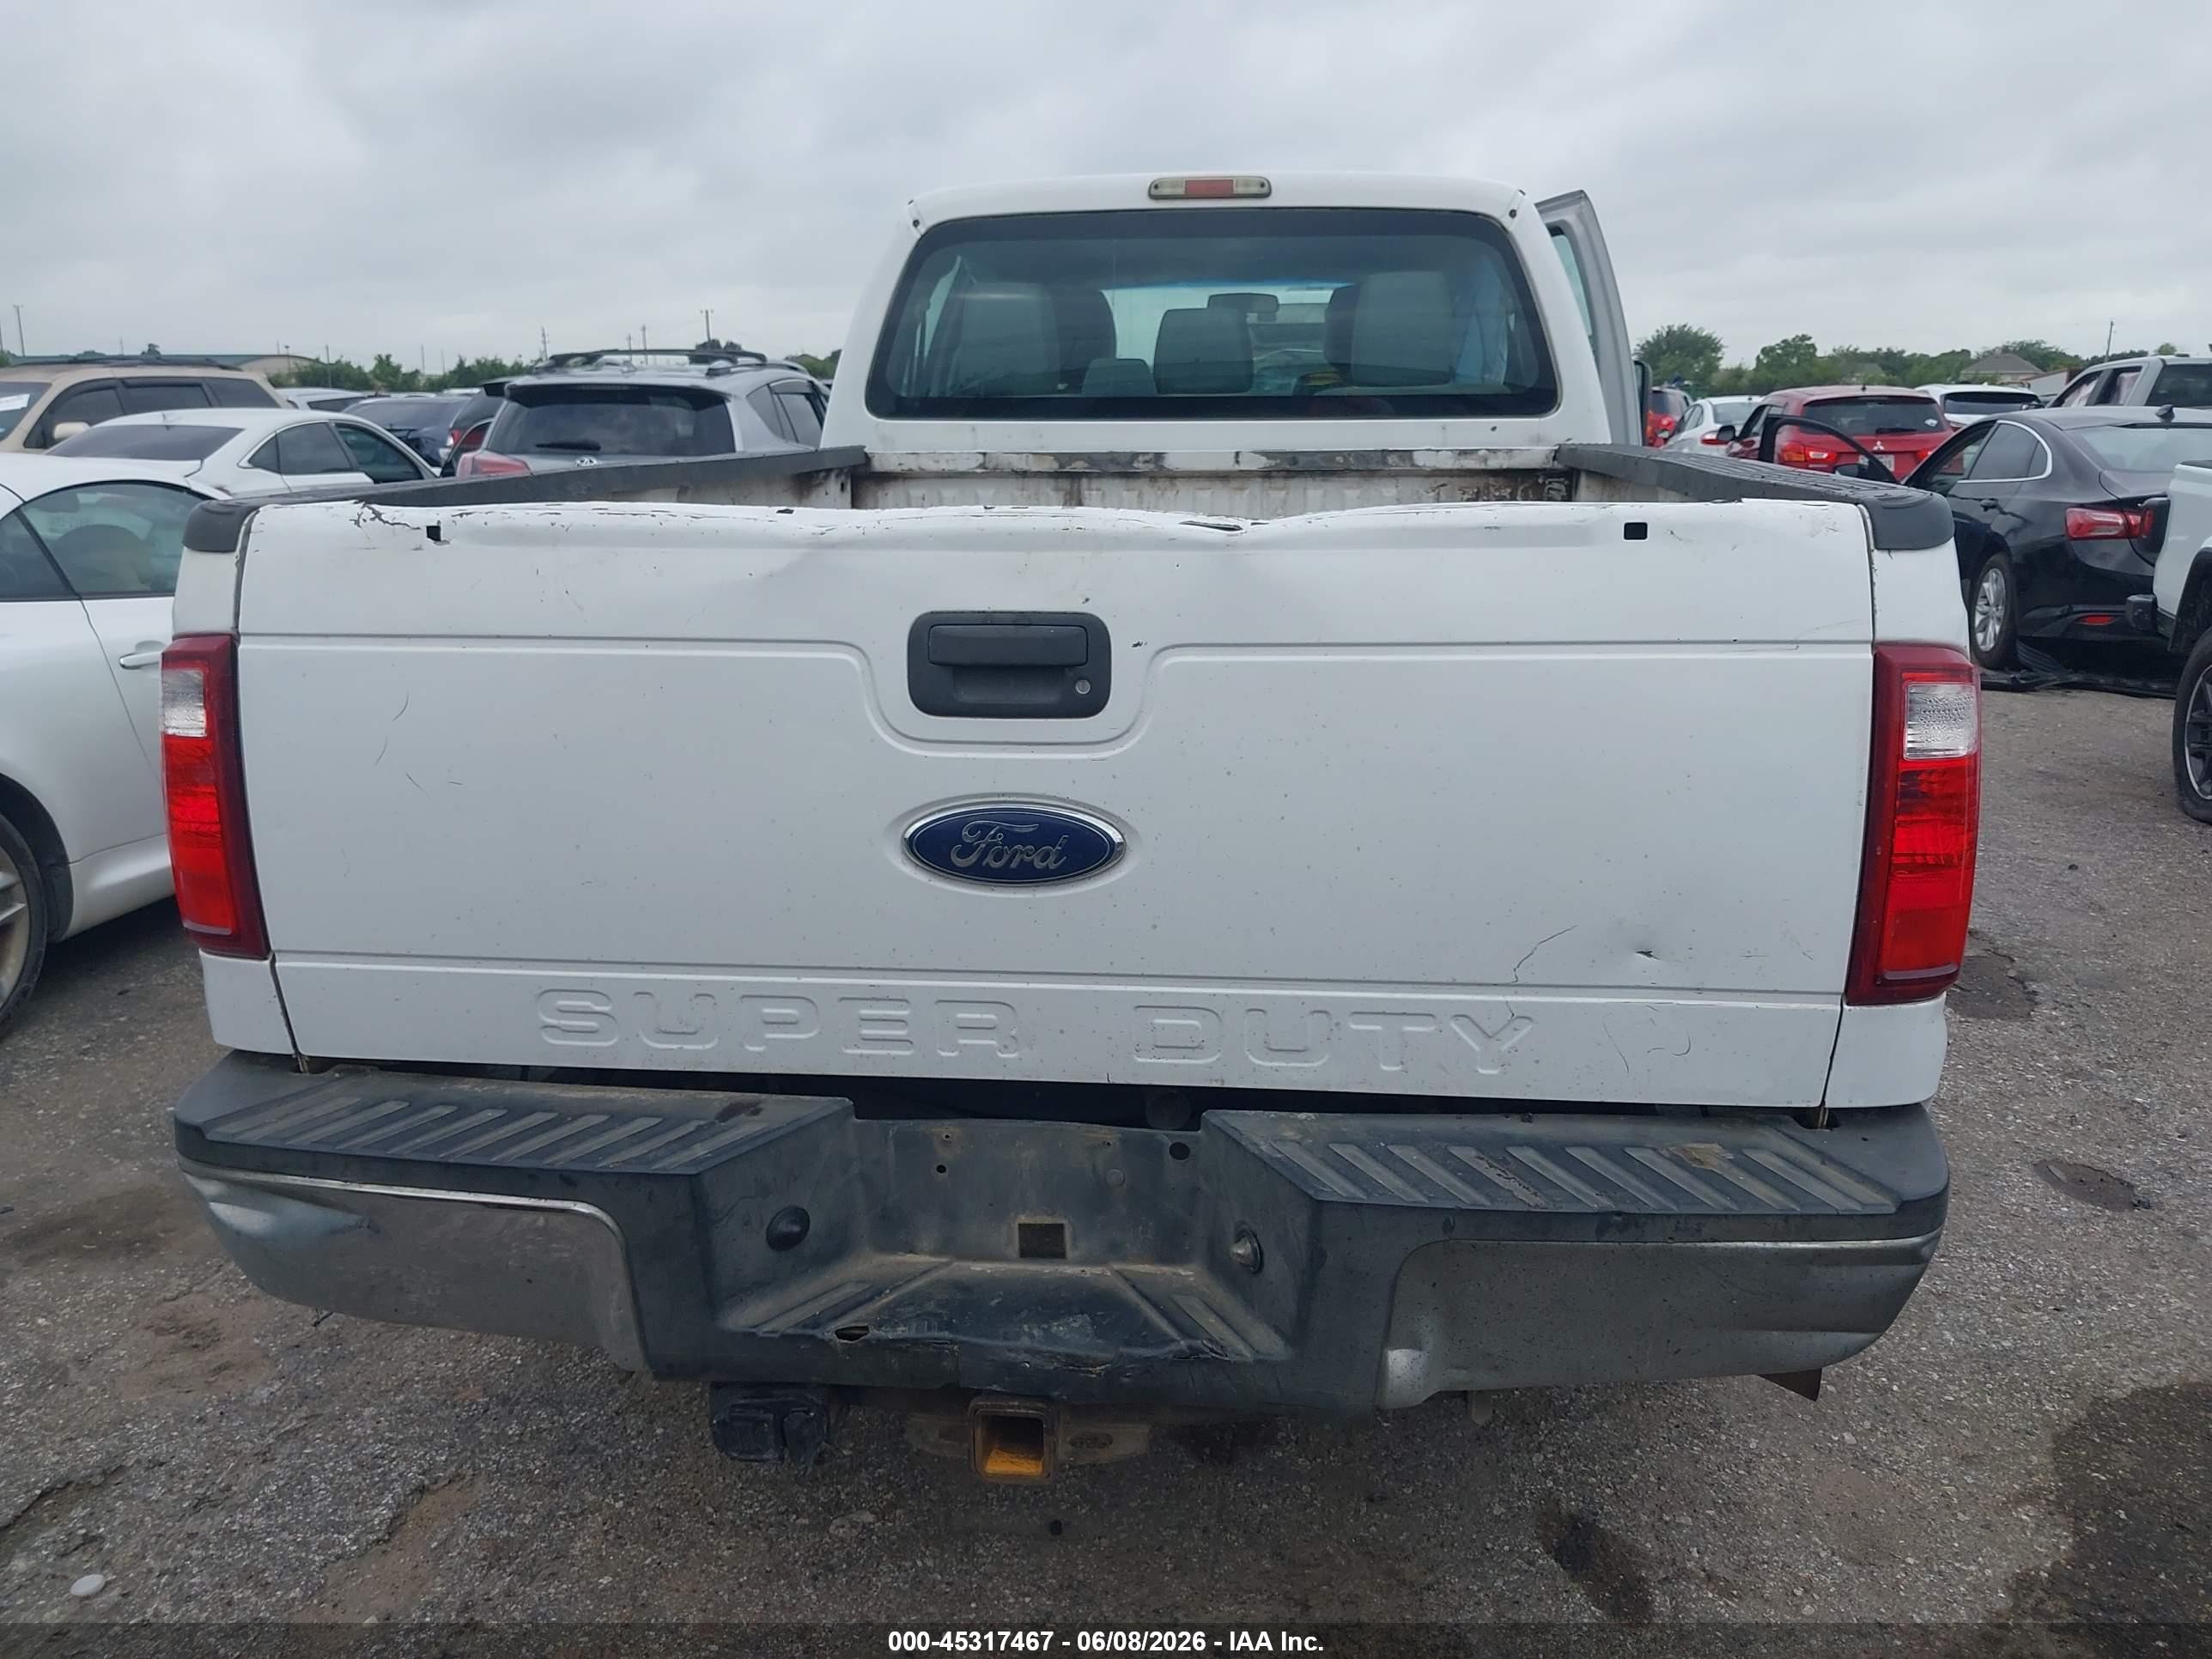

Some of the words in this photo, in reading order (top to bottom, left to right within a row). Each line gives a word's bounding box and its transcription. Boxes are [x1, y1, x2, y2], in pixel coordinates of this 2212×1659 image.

[950, 819, 1071, 870] Ford
[536, 988, 1020, 1059] SUPER
[1133, 1004, 1534, 1076] DUTY
